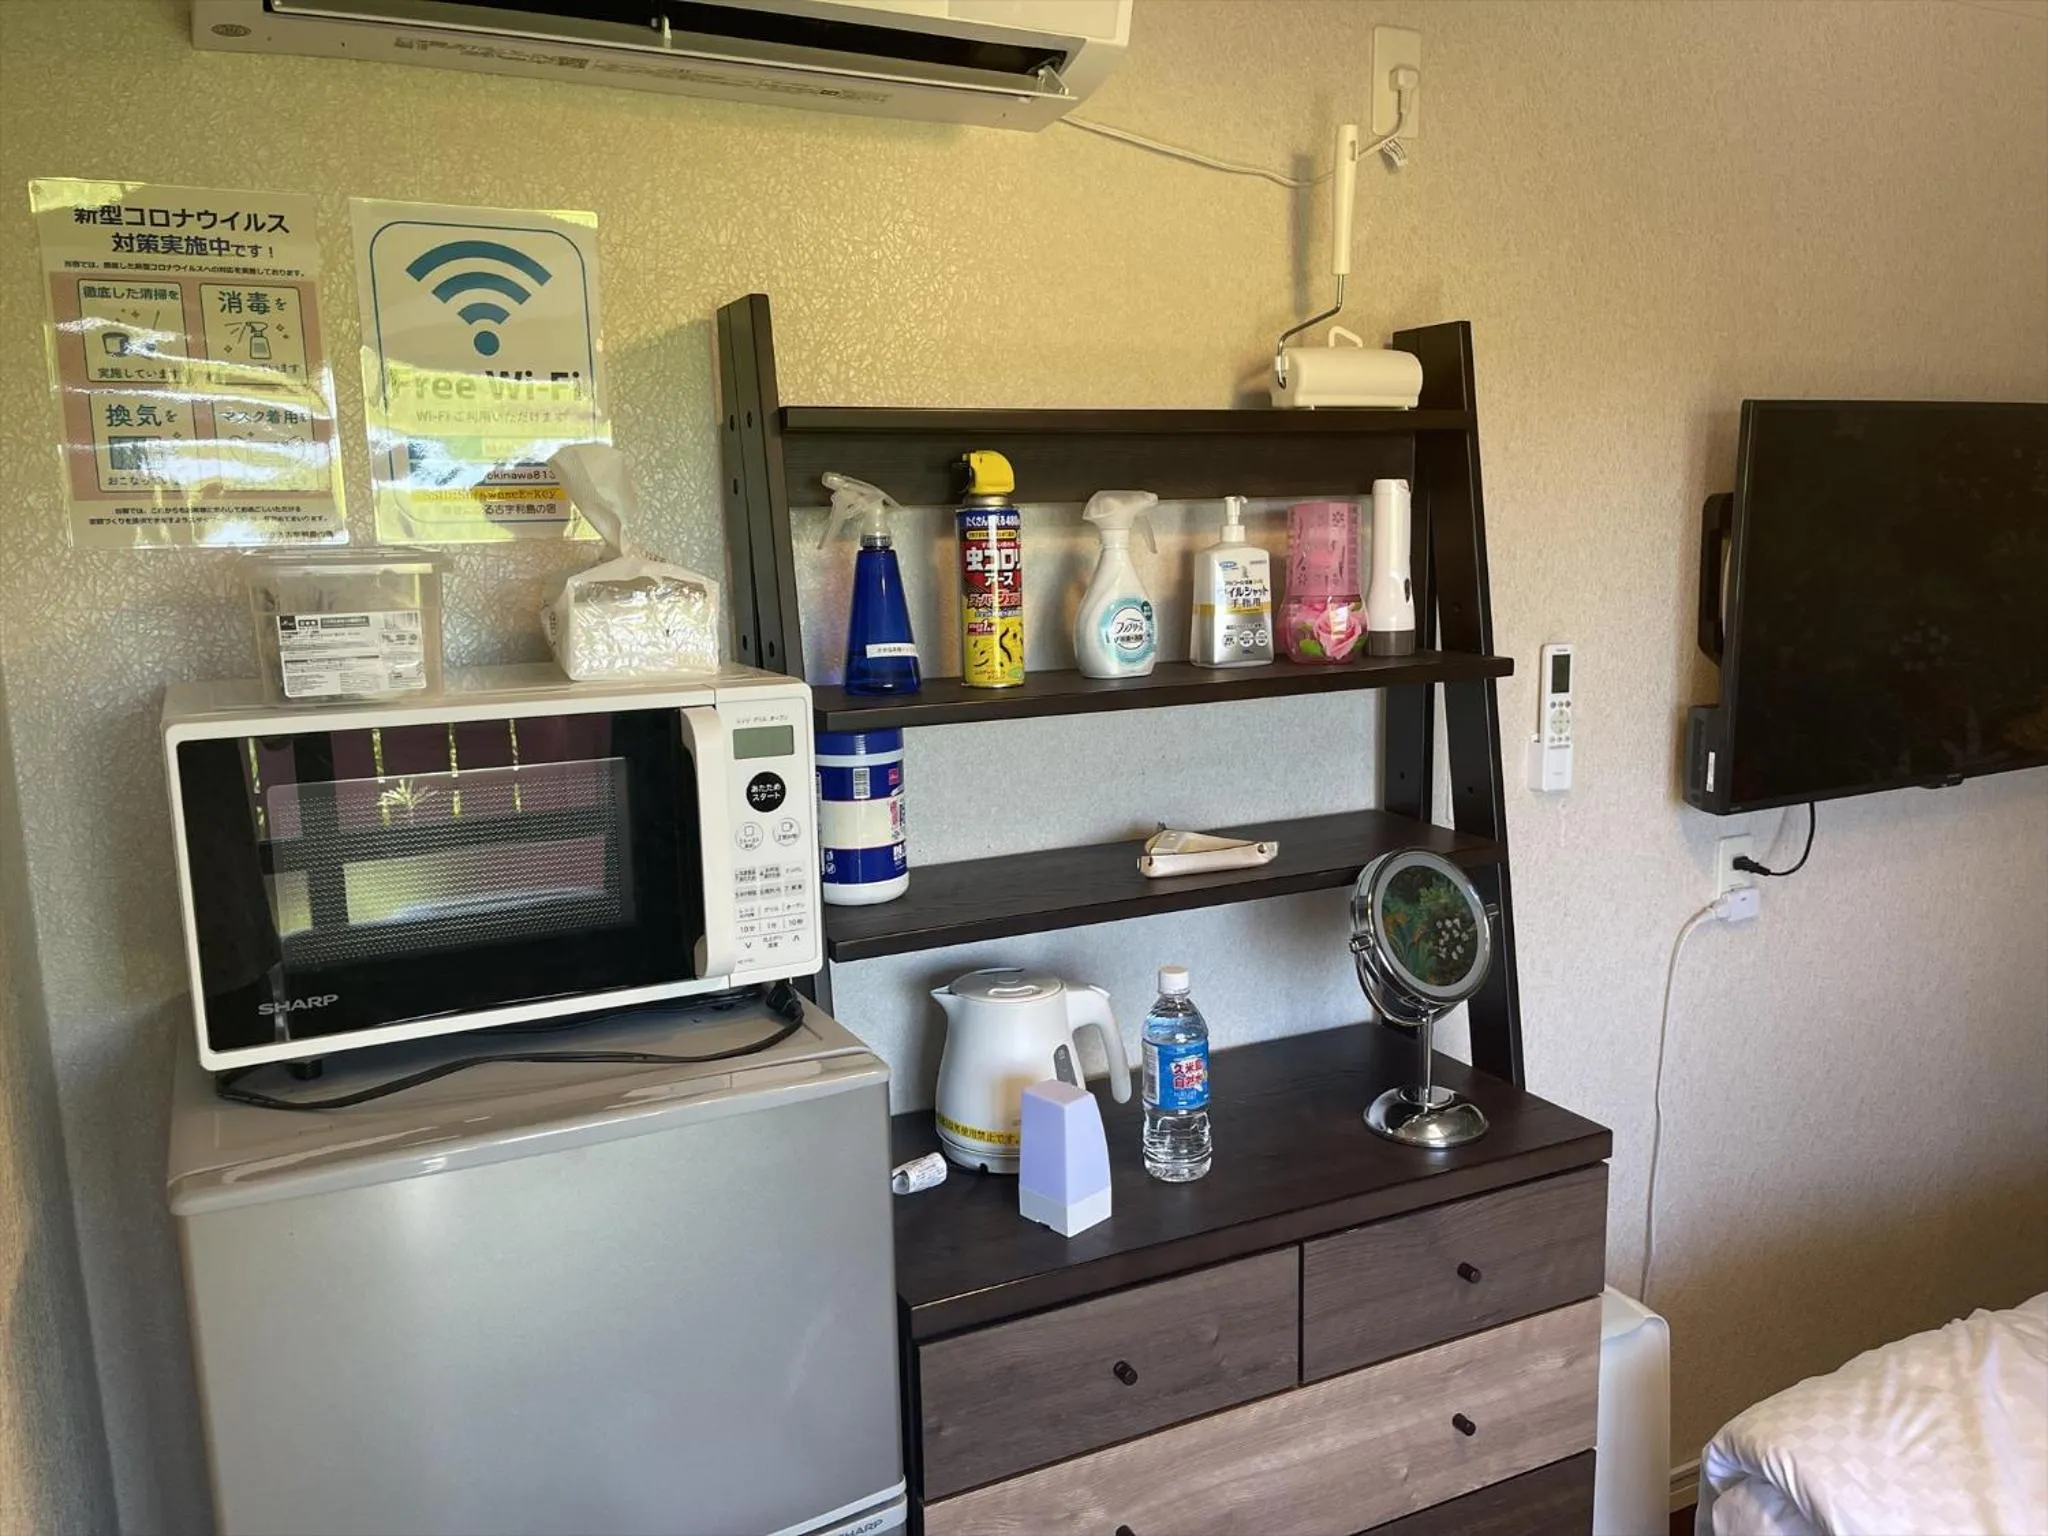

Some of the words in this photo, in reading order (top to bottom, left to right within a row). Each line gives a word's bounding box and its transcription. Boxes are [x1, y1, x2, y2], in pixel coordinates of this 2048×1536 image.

[74, 205, 290, 234] 新型コロナウイルス
[111, 232, 275, 259] 対策実施中です！
[82, 286, 180, 301] 徹底した清掃を
[217, 290, 287, 316] 消毒を
[391, 366, 476, 400] Free
[105, 403, 177, 428] 換気を
[750, 784, 782, 793] あたため
[752, 792, 781, 801] スタート
[257, 994, 340, 1016] SHARP
